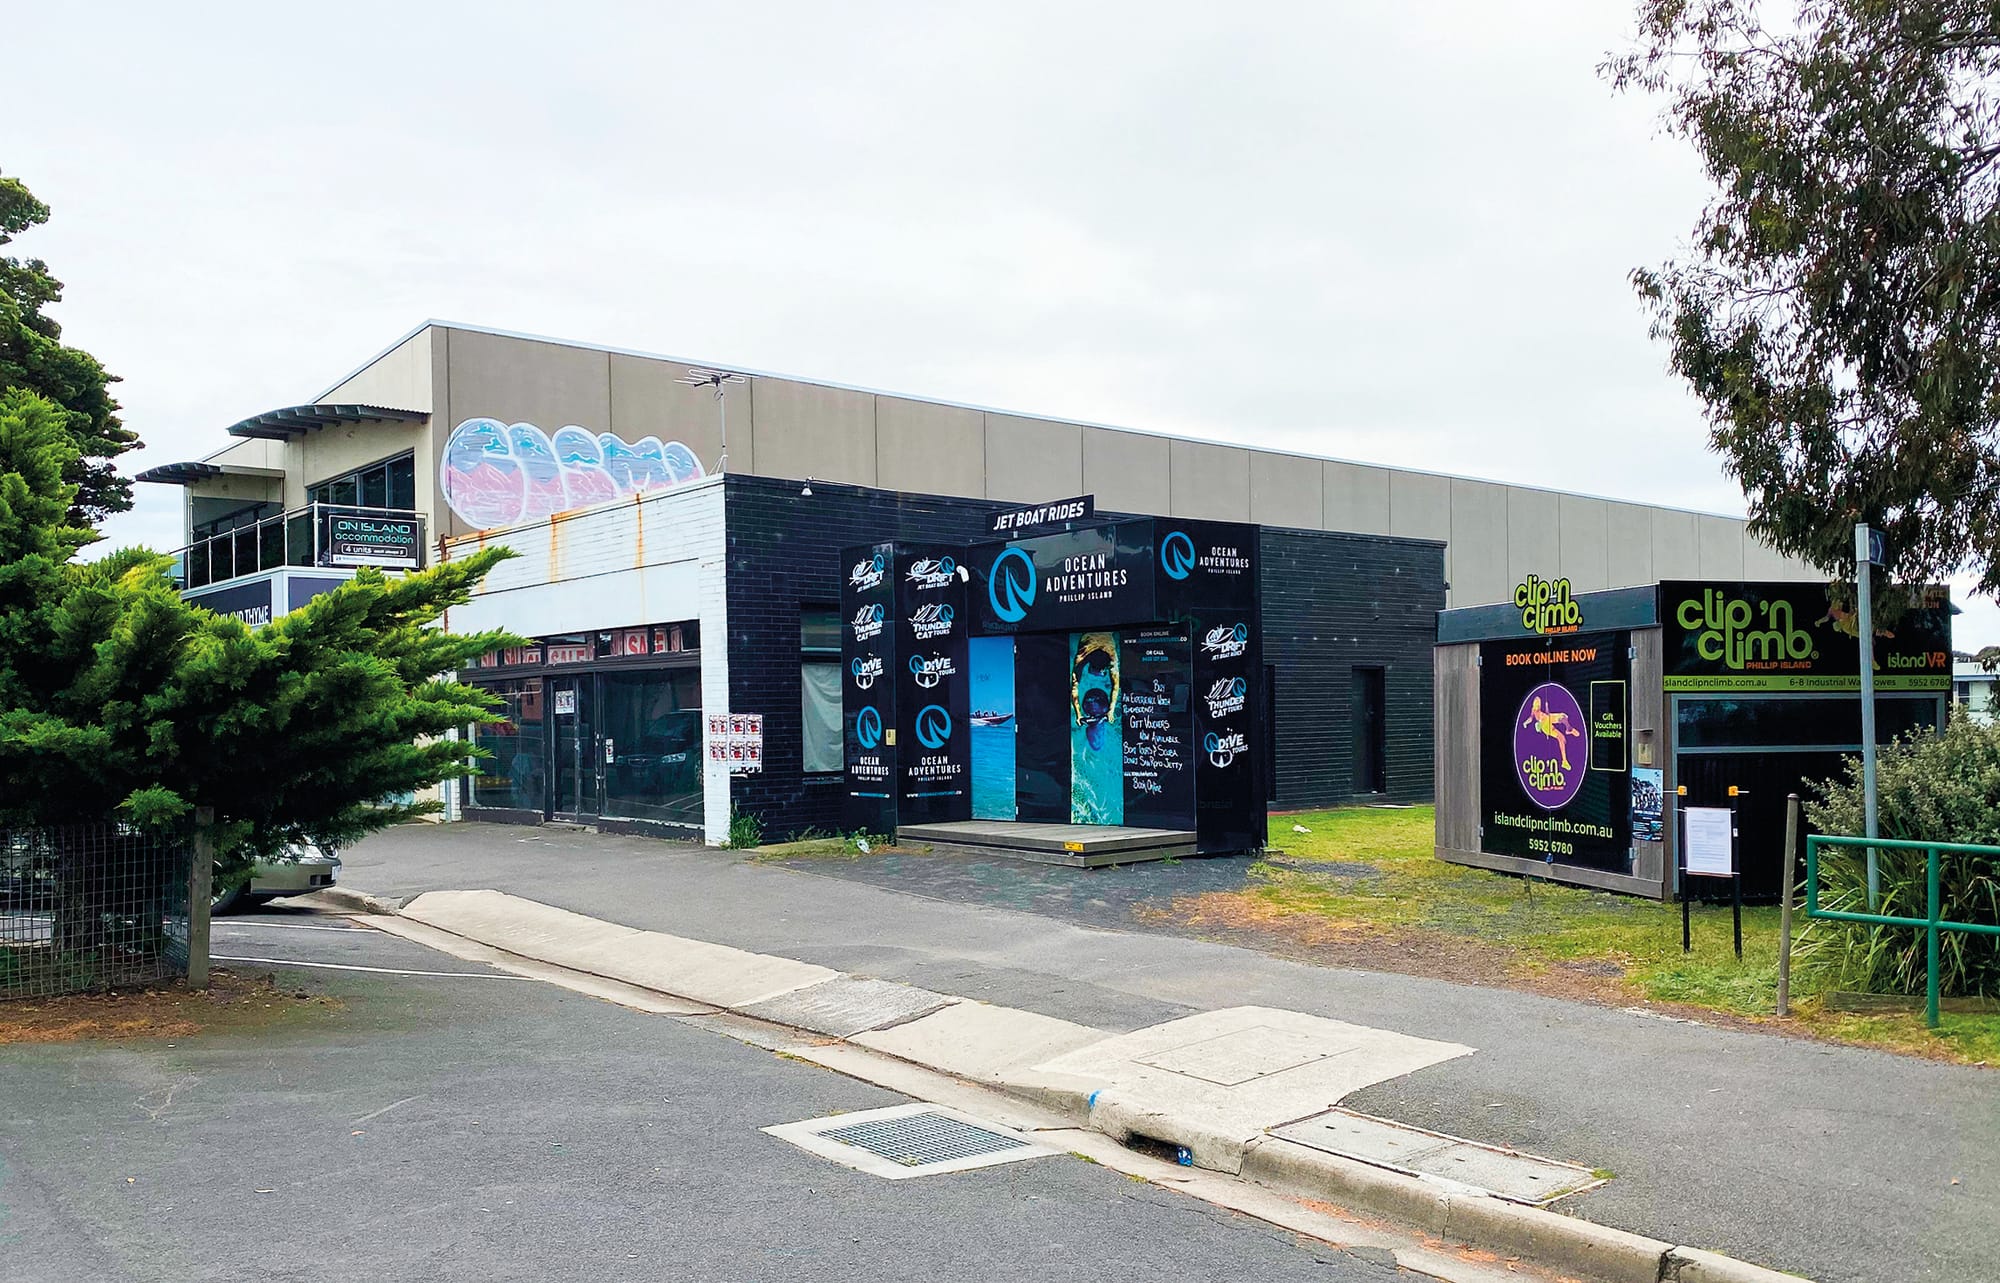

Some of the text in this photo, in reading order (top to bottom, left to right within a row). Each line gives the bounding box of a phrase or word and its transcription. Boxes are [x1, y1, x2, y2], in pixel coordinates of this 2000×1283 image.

[993, 502, 1085, 531] JET BOAT RIDES
[338, 521, 410, 534] ON ISLAND
[335, 533, 413, 544] accommodation
[345, 545, 352, 553] 4
[353, 546, 372, 554] units
[1212, 547, 1237, 557] OCEAN
[1065, 554, 1105, 573] OCEAN
[1199, 557, 1249, 568] ADVENTURES
[927, 572, 955, 583] DRIFT
[1046, 569, 1127, 592] ADVENTURES
[1059, 591, 1112, 602] PHILLIP ISLAND
[1515, 575, 1550, 607] clip
[1677, 588, 1752, 630] clip
[244, 605, 269, 626] THYME
[854, 621, 883, 634] THUNDER
[912, 621, 952, 633] THUNDER
[856, 632, 870, 642] CAT
[916, 631, 933, 640] CAT
[1698, 610, 1813, 669] climb
[1221, 640, 1247, 653] DRIFT
[1506, 649, 1597, 666] BOOK ONLINE NOW
[1746, 661, 1812, 670] PHILLIP ISLAND
[939, 668, 956, 676] TOURS
[1664, 678, 1767, 689] slandclipnclimb.com.au
[1789, 678, 1804, 687] 6-8
[1806, 678, 1846, 687] Industrial
[1873, 679, 1896, 687] owes
[1908, 679, 1951, 687] 5952 6780
[1208, 695, 1245, 711] THUNDER
[1211, 708, 1227, 718] CAT
[1602, 713, 1614, 721] Gift
[1594, 721, 1622, 729] Vouchers
[1594, 730, 1622, 738] Available
[860, 756, 880, 765] OCEAN
[921, 756, 948, 765] OCEAN
[1523, 755, 1545, 774] clip
[851, 766, 889, 776] ADVENTURES
[908, 765, 961, 776] ADVENTURES
[1494, 811, 1613, 838] islandclipnclimb.com.au
[1529, 838, 1573, 855] 5952 6780
